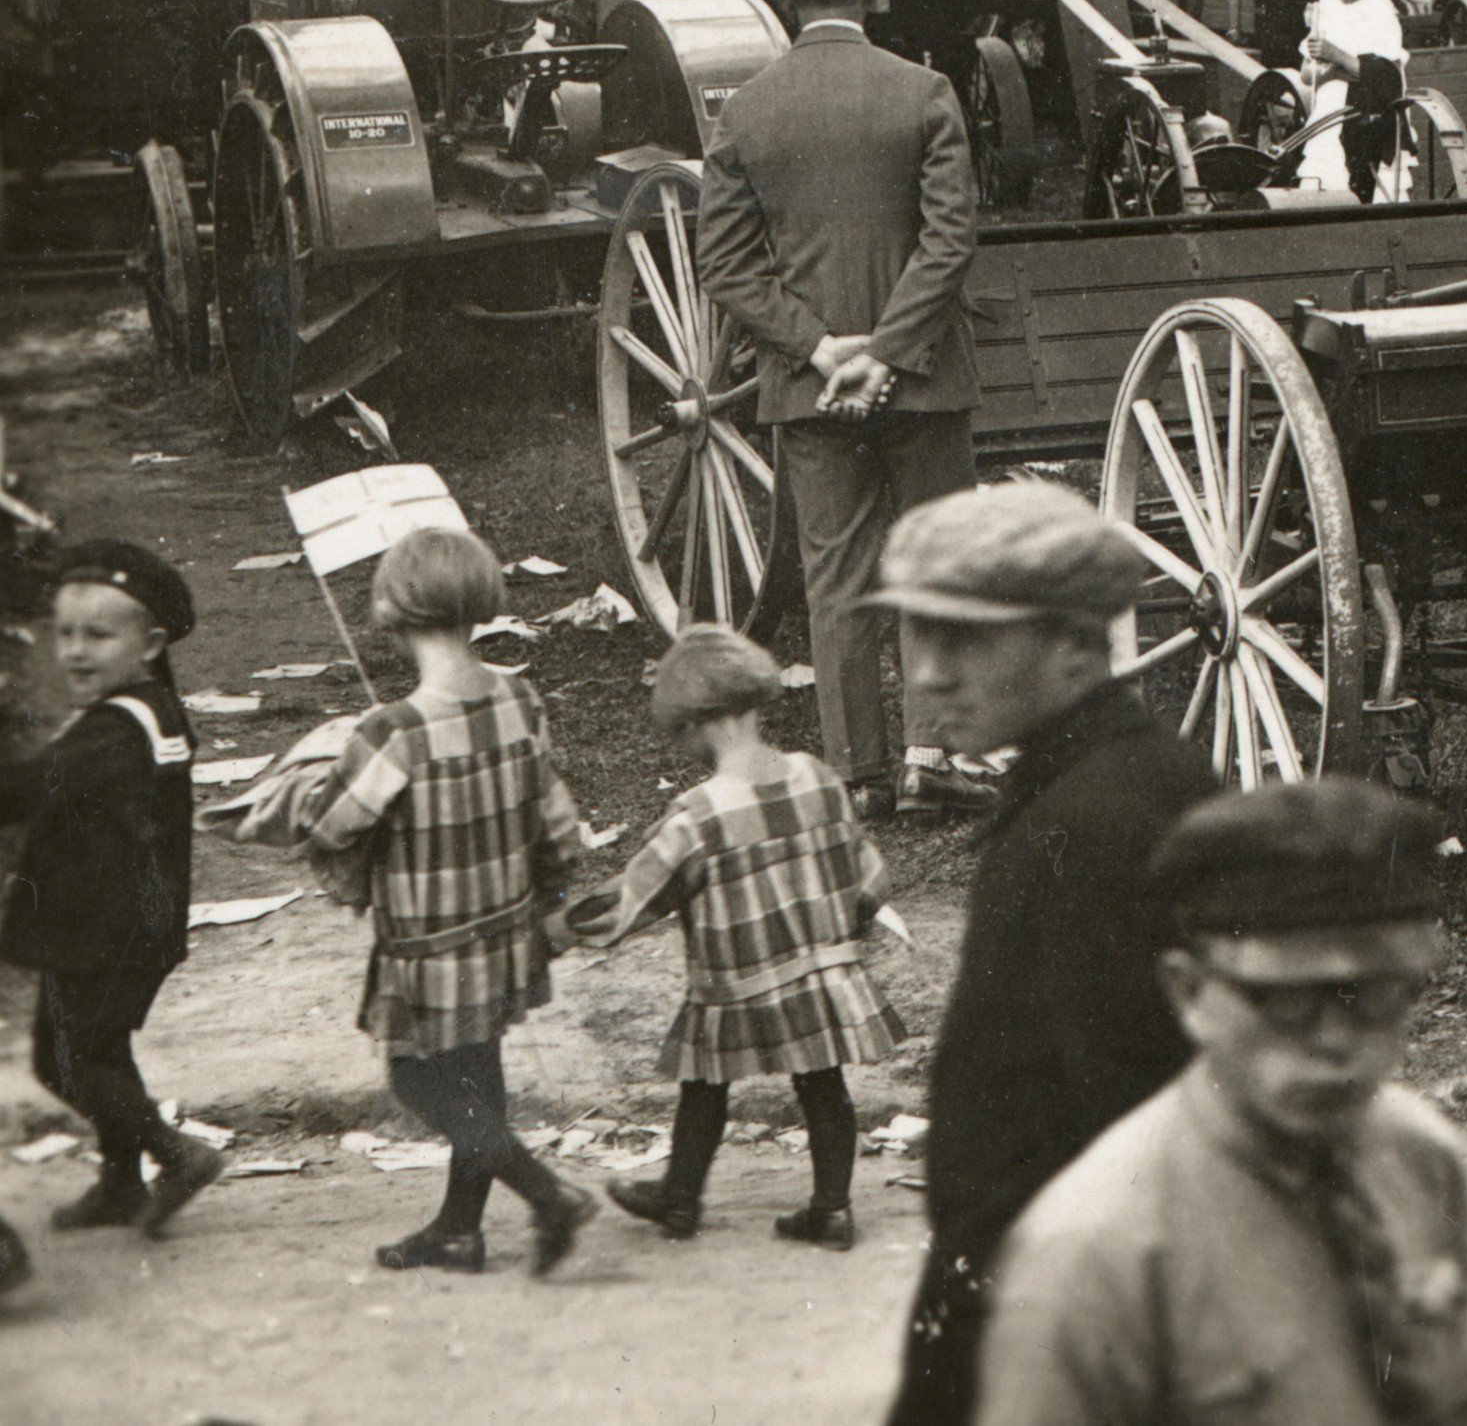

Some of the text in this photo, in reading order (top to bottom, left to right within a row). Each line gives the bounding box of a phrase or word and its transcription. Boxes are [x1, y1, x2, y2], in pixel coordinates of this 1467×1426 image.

[703, 88, 740, 99] INTER
[323, 115, 407, 130] INTERNATIONAL
[347, 128, 386, 139] 10-20
